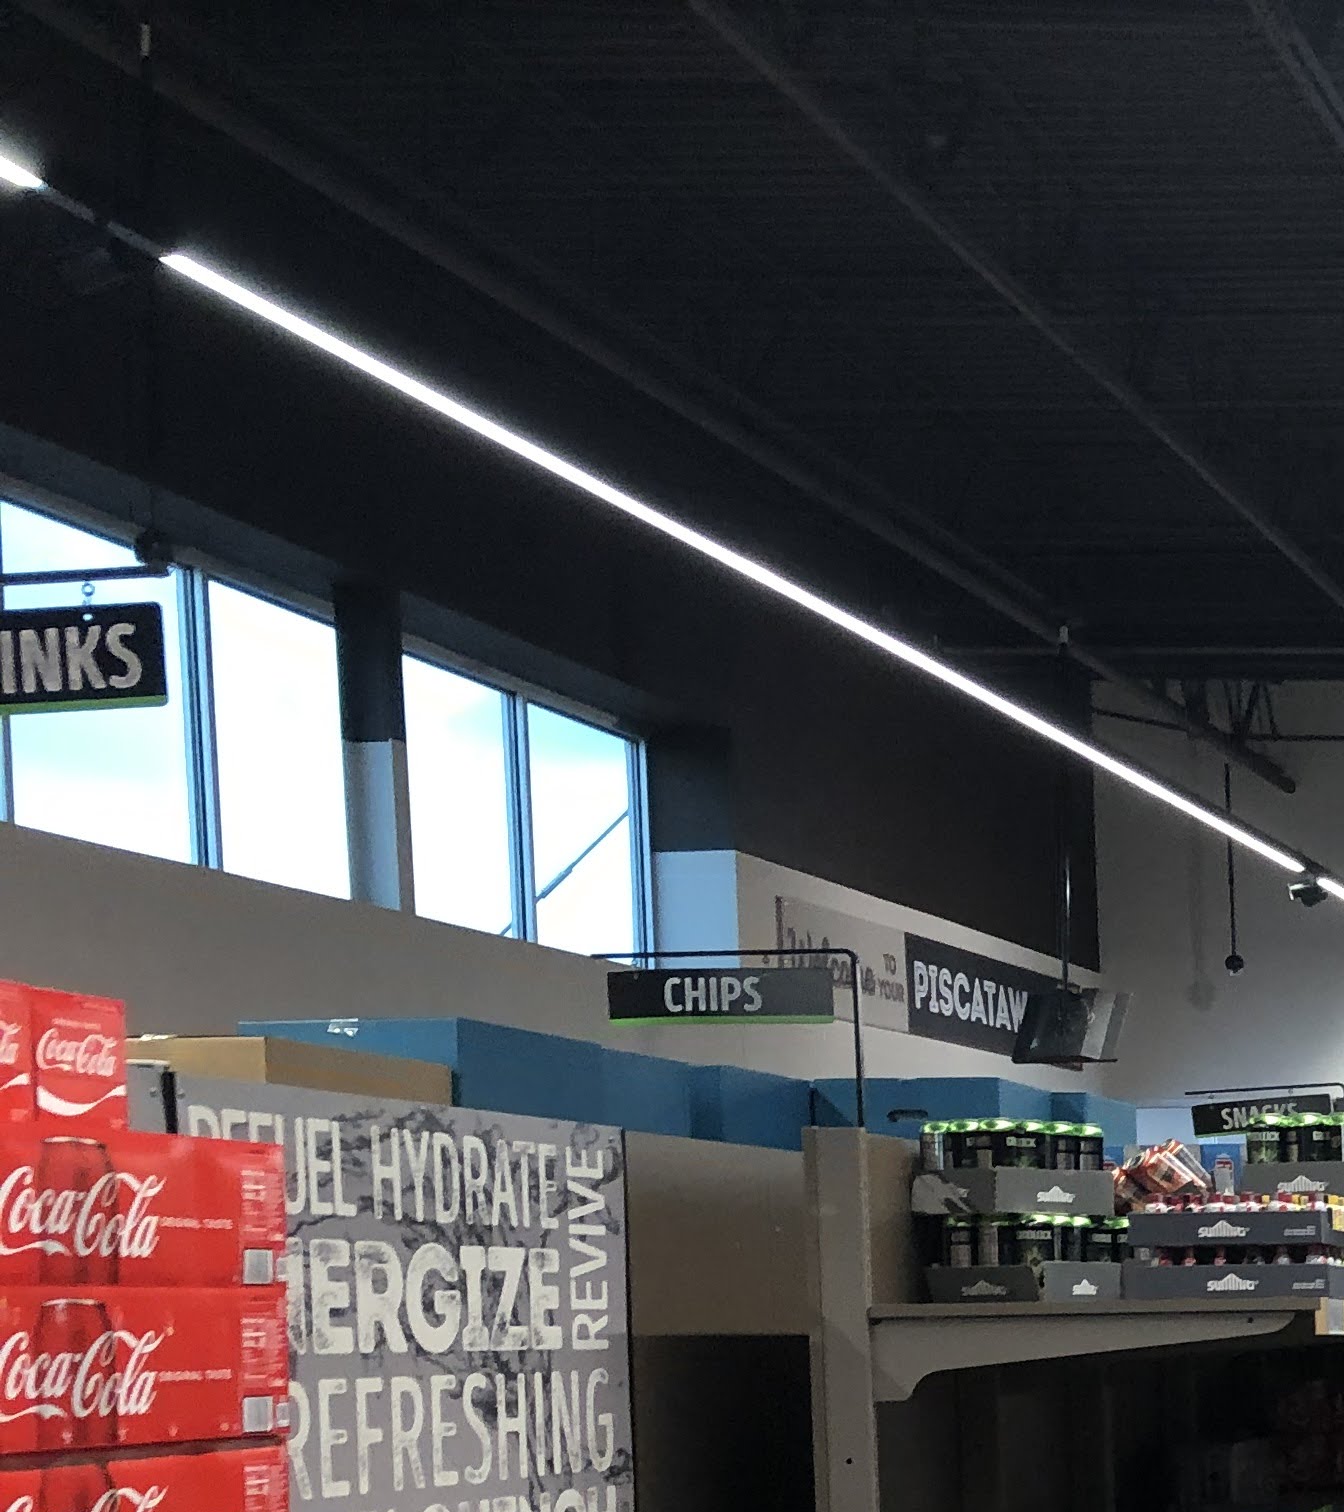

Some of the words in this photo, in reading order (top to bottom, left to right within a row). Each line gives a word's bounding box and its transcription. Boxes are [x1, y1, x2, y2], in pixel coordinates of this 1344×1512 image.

[663, 976, 764, 1014] CHIPS
[883, 953, 898, 976] TO
[371, 1125, 560, 1231] HYDRATE
[564, 1146, 611, 1351] REVIVE
[286, 1366, 616, 1501] REFRESHING
